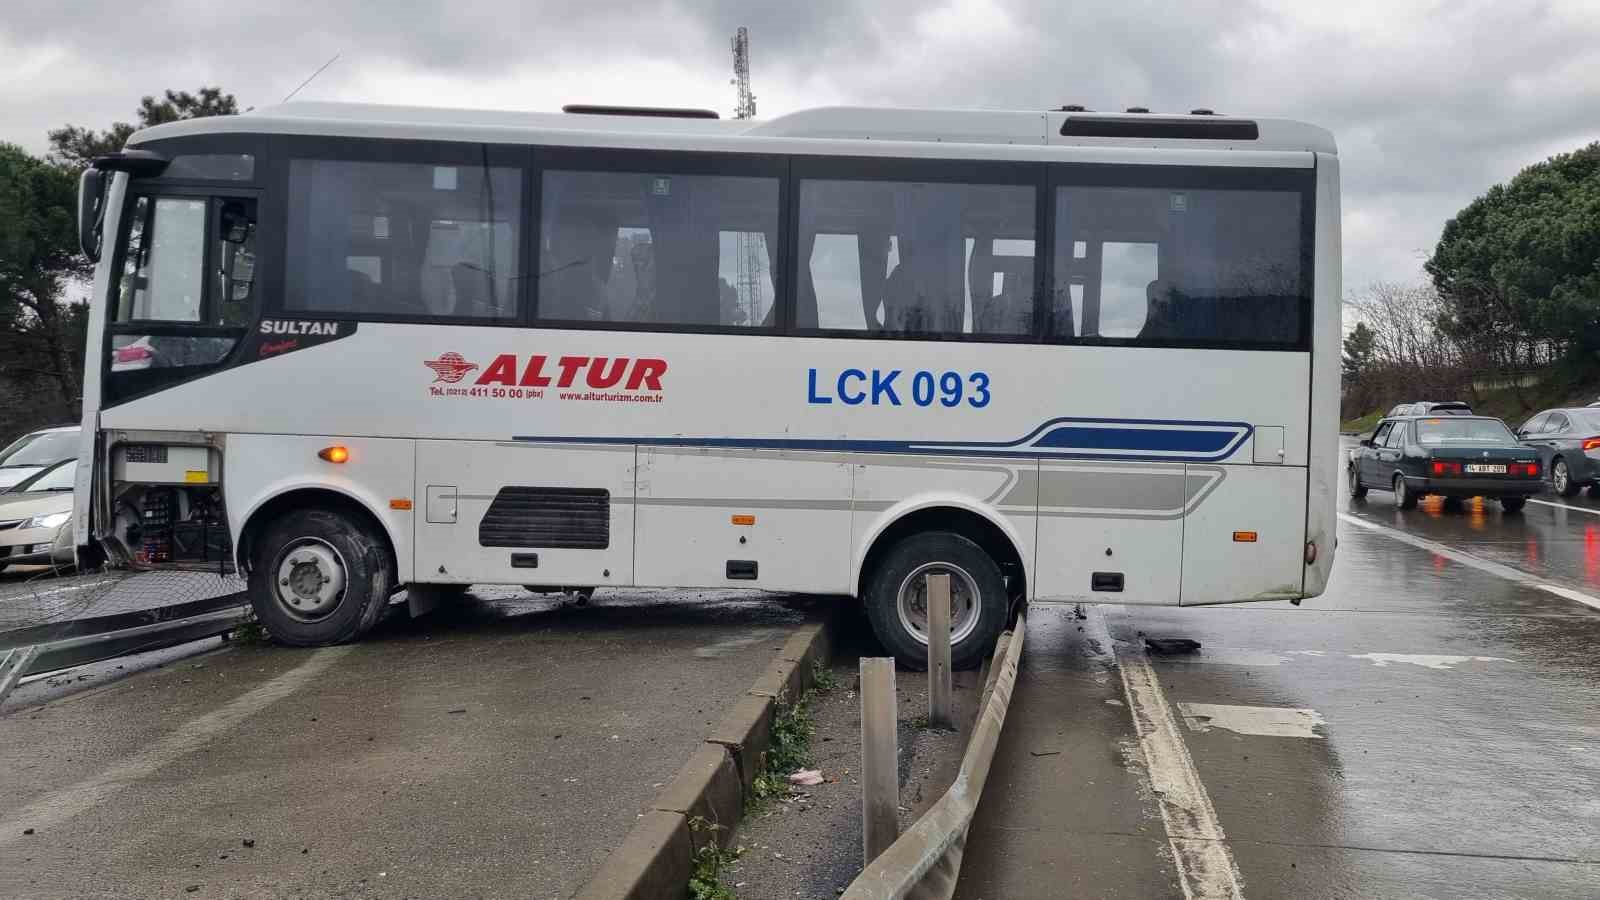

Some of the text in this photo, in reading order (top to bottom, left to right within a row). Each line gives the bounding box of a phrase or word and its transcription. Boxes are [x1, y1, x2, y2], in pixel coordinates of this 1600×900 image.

[259, 320, 338, 335] SULTAN
[474, 354, 668, 390] ALTUR
[469, 388, 488, 397] 411
[492, 388, 506, 397] 50
[508, 389, 523, 398] 00
[807, 368, 991, 408] LCK 093
[560, 391, 663, 402] www.alturturizm.com.tr
